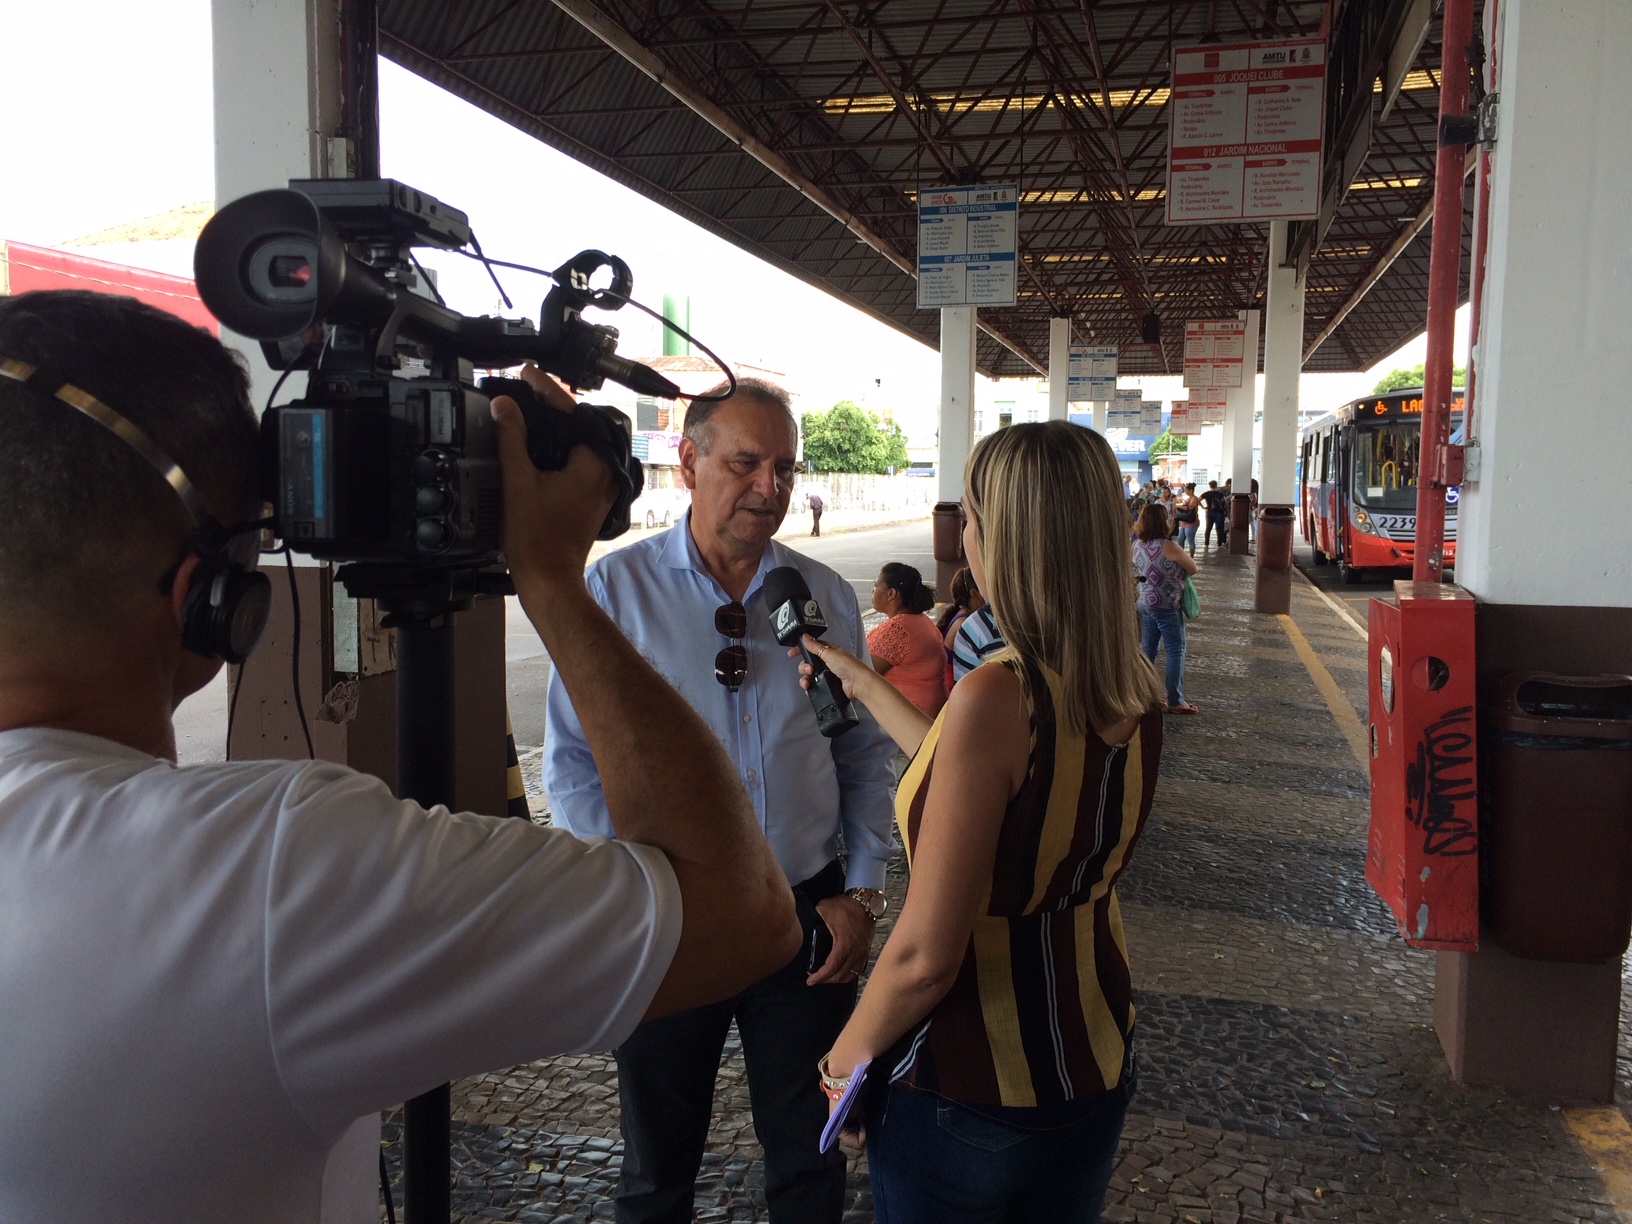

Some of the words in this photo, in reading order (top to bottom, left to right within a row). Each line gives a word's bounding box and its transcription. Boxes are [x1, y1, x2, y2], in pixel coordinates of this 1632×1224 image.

[1263, 52, 1286, 60] AMTU
[1214, 74, 1226, 83] 005
[1229, 71, 1257, 83] JÓQUEI
[1258, 70, 1284, 80] CLUBE
[1204, 148, 1216, 157] 012
[1219, 146, 1247, 156] JARDIM
[1248, 144, 1288, 154] NACIONAL
[948, 206, 969, 214] DISTRITO
[970, 204, 996, 212] INDUSTRIAL
[971, 254, 989, 262] JULIETA
